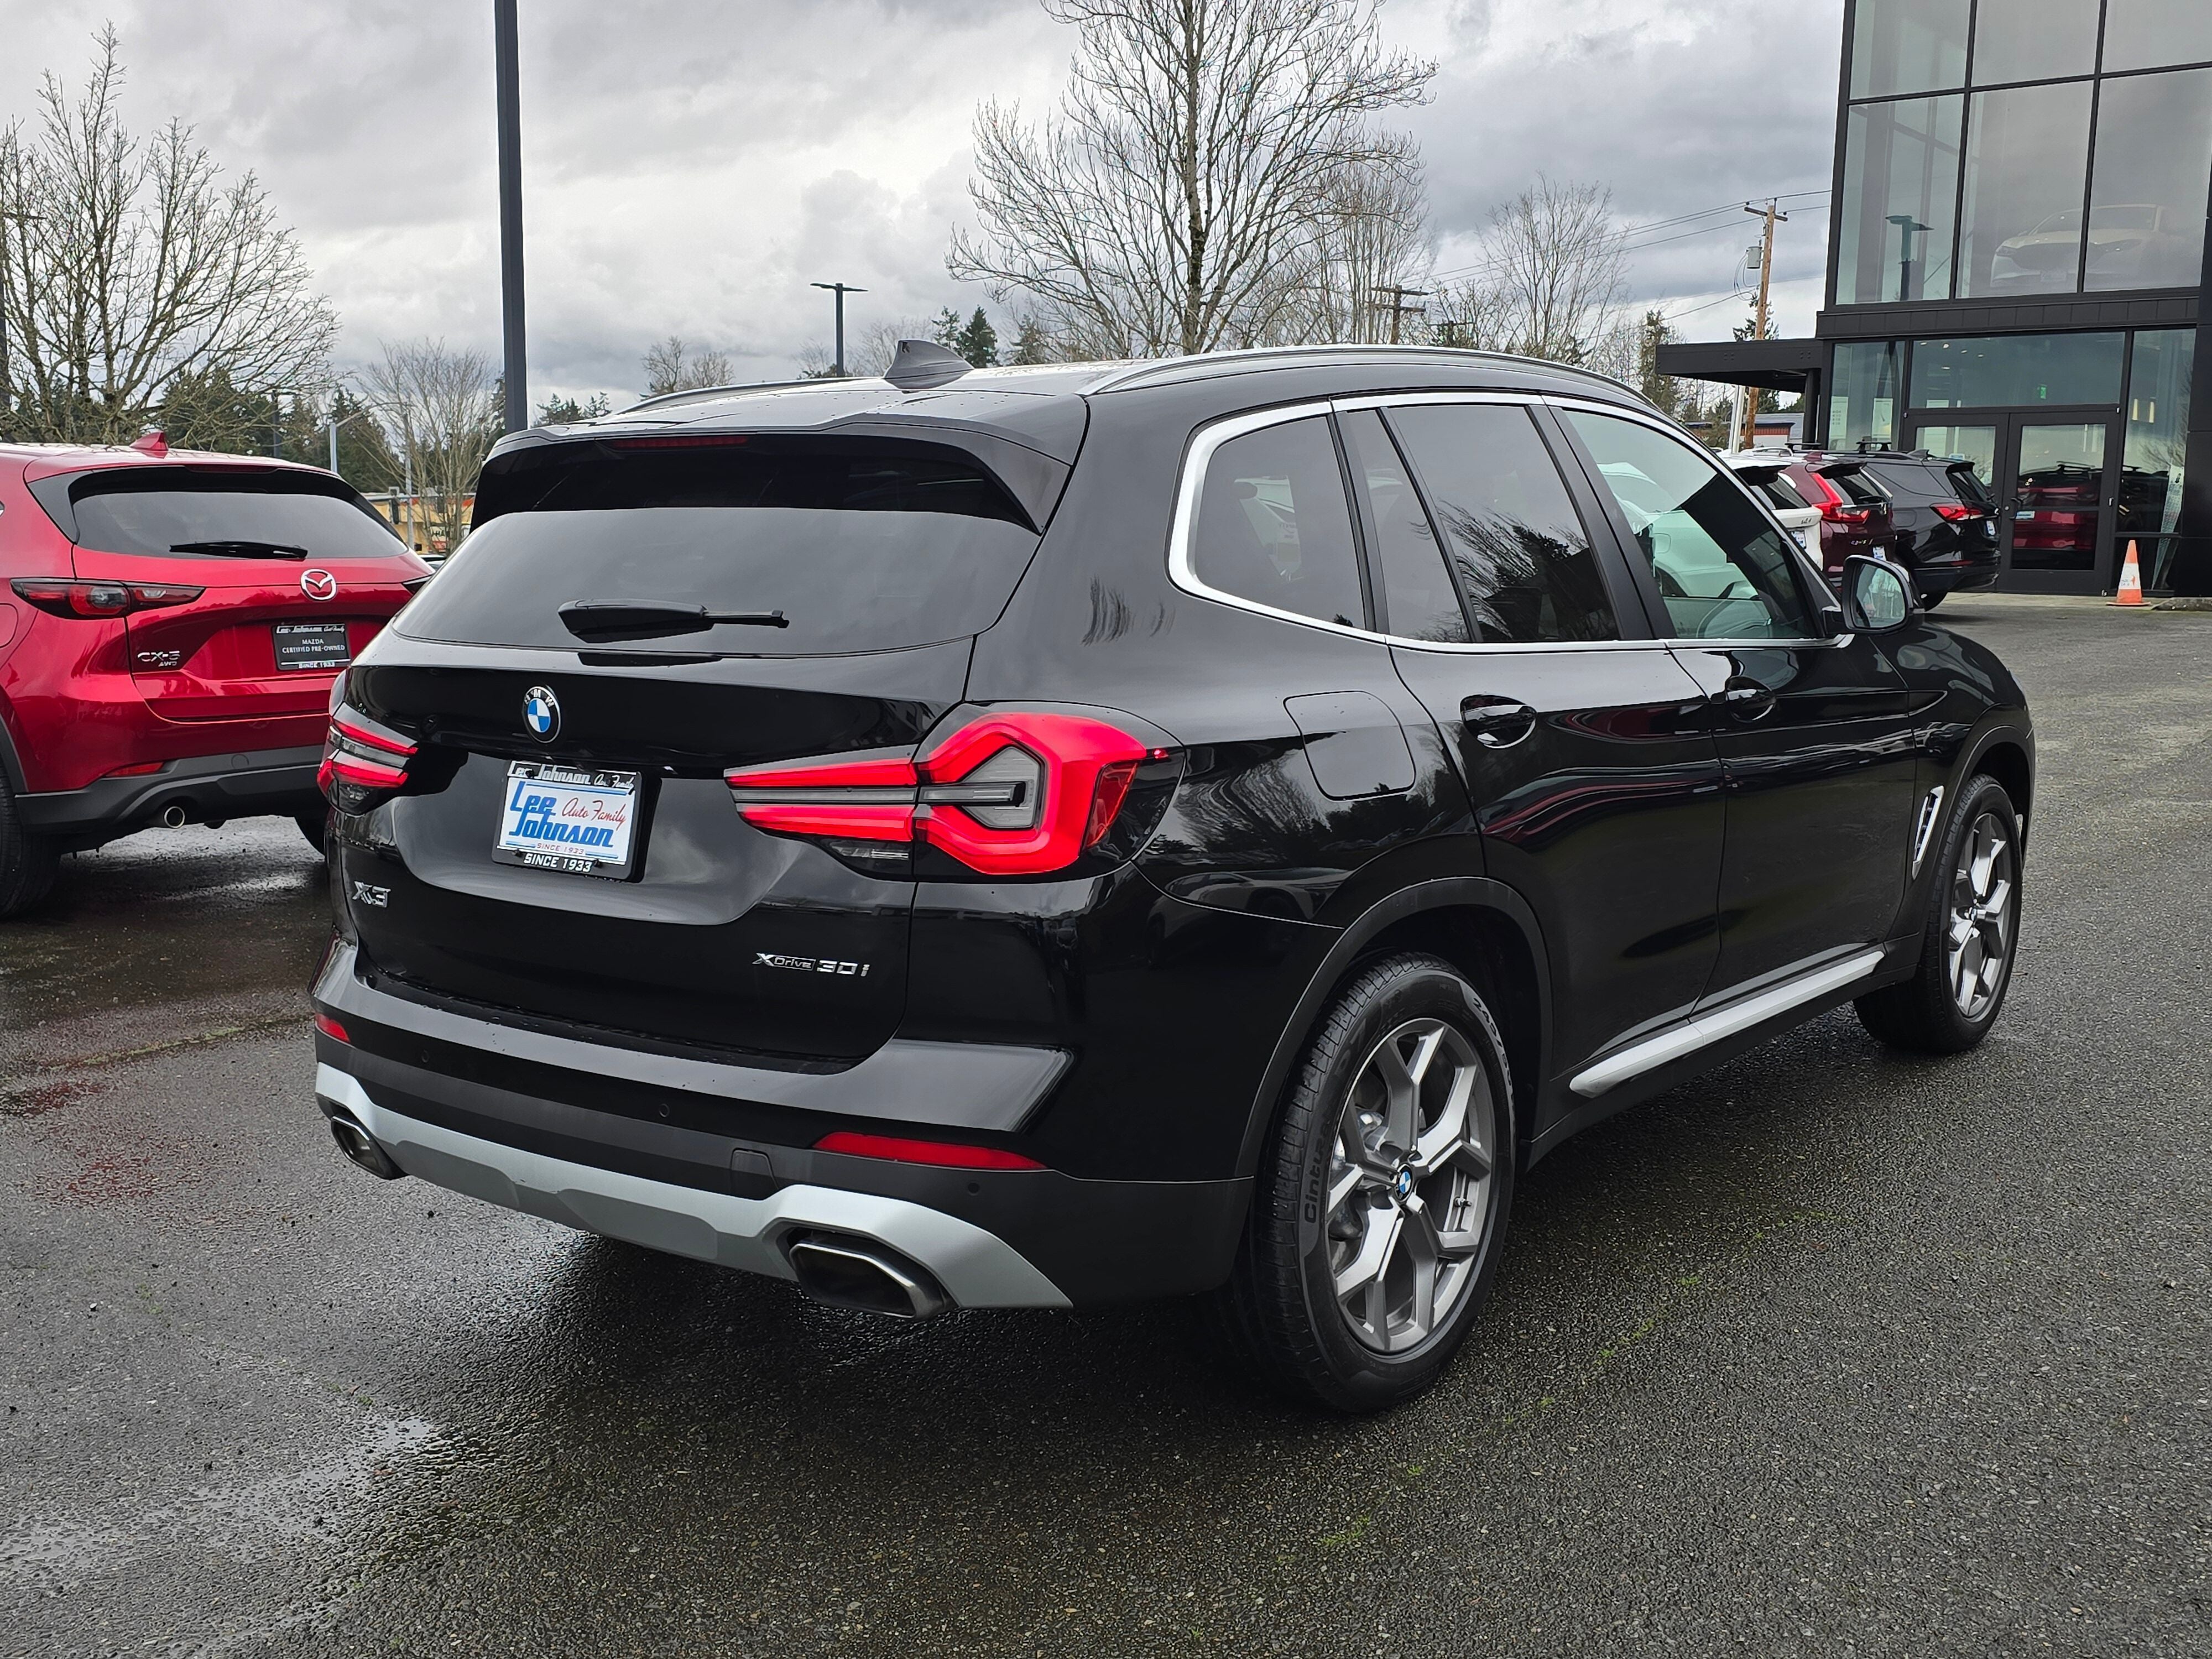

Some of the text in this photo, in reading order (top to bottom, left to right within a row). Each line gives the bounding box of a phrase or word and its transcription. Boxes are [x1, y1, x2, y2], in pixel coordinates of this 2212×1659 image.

[137, 650, 180, 662] CX-5
[534, 764, 591, 785] Johnson
[510, 780, 557, 815] Lee
[562, 797, 627, 831] Auto Family
[508, 810, 614, 848] Johnson
[537, 843, 561, 852] SINCE
[524, 853, 592, 873] SINCE 1933
[352, 881, 392, 908] X3
